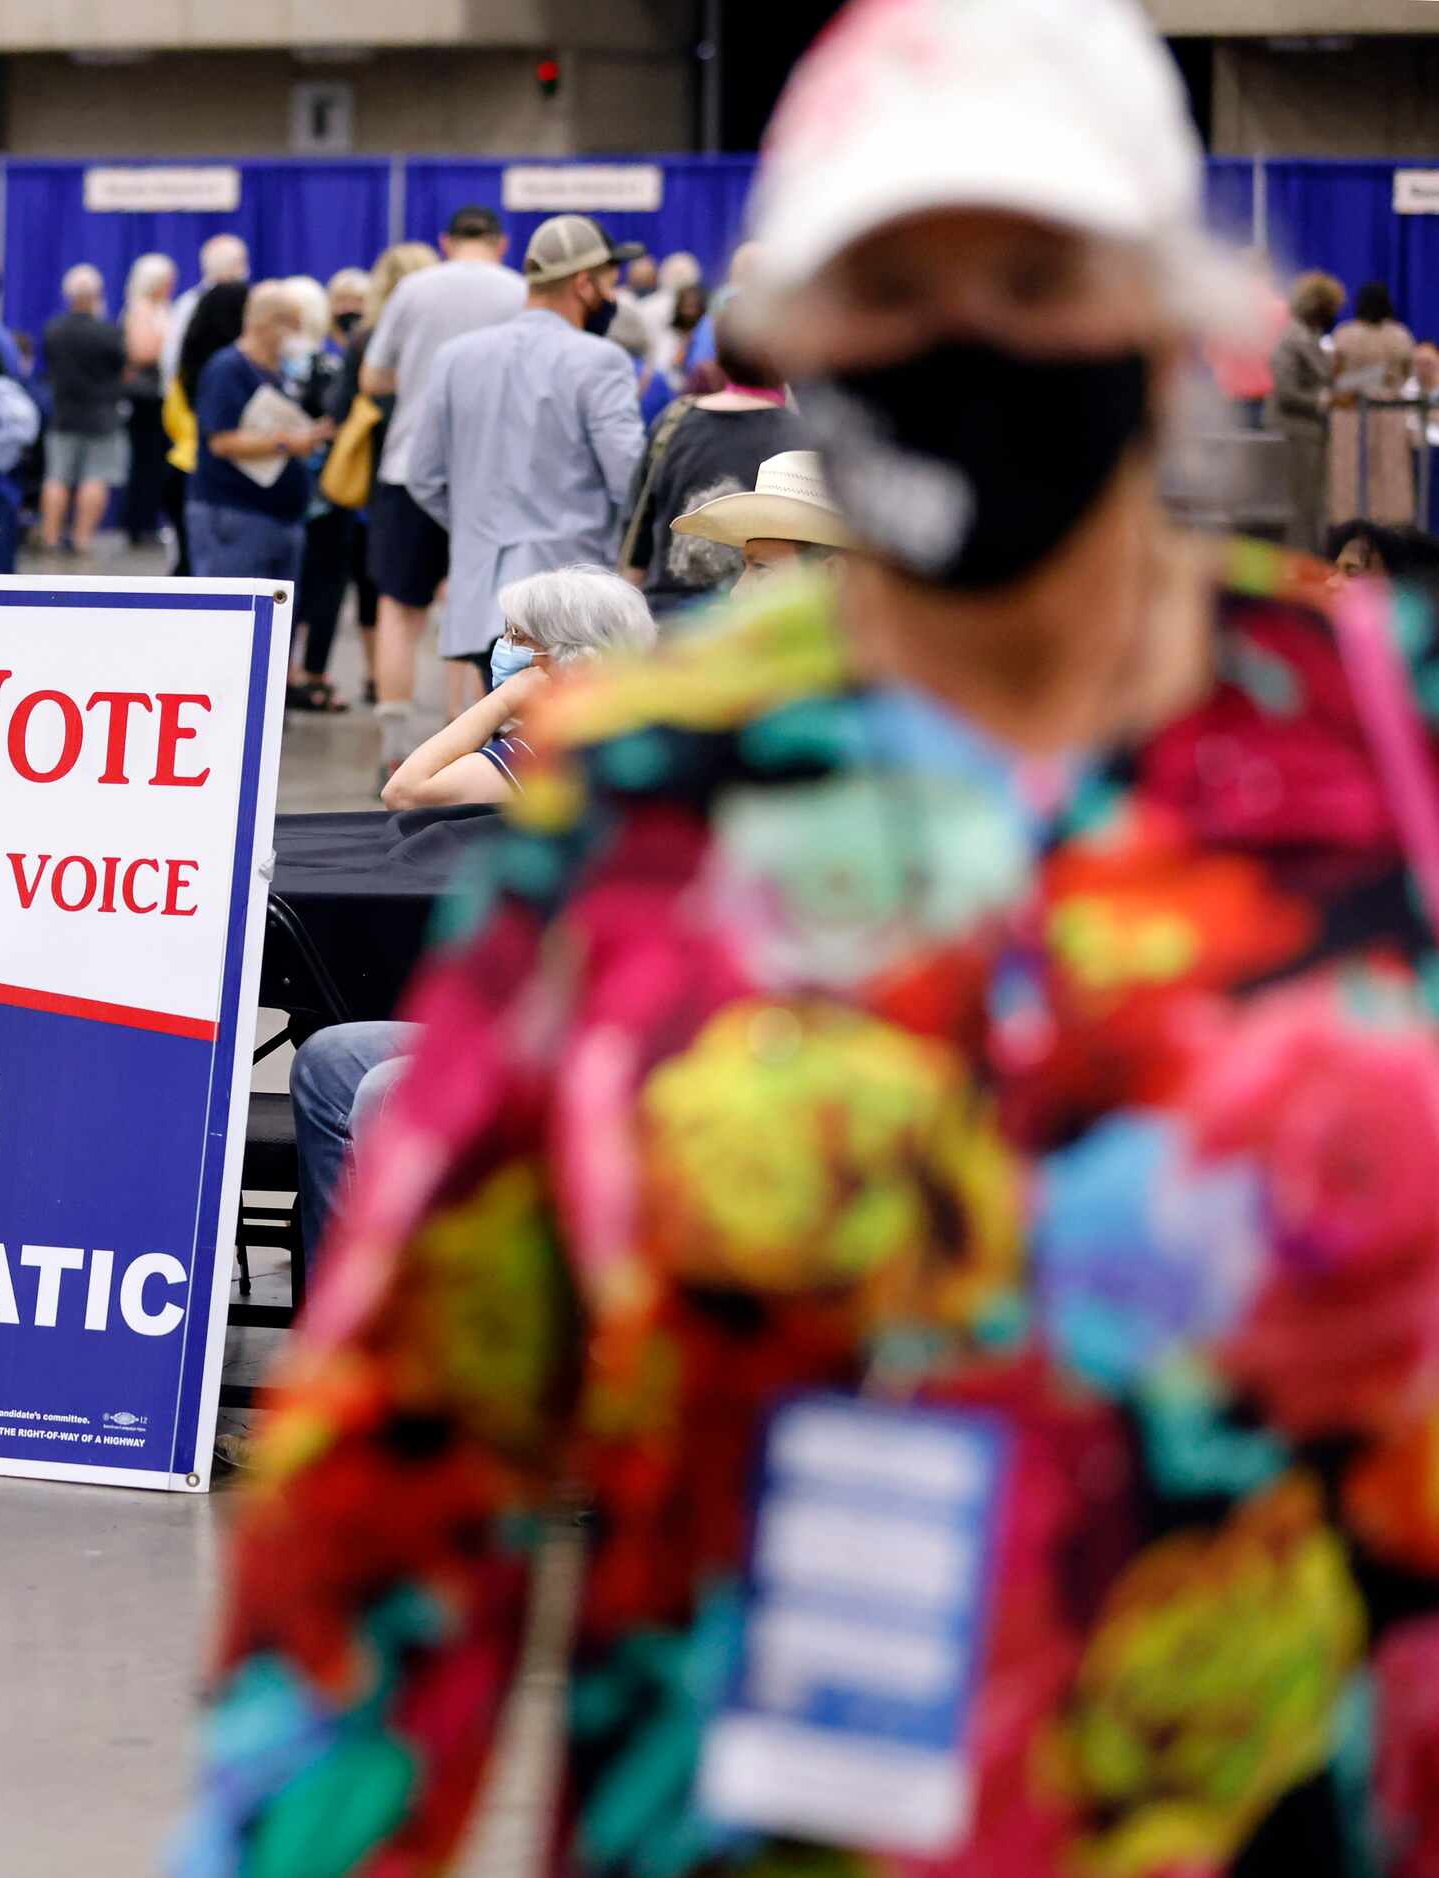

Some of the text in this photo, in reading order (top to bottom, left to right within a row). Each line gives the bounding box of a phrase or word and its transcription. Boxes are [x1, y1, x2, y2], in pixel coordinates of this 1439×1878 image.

[8, 852, 199, 917] VOICE
[43, 1414, 90, 1424] committee.
[18, 1429, 79, 1441] RIGHT-OF-WAY
[81, 1434, 93, 1442] OF
[103, 1436, 145, 1447] HIGHWAY
